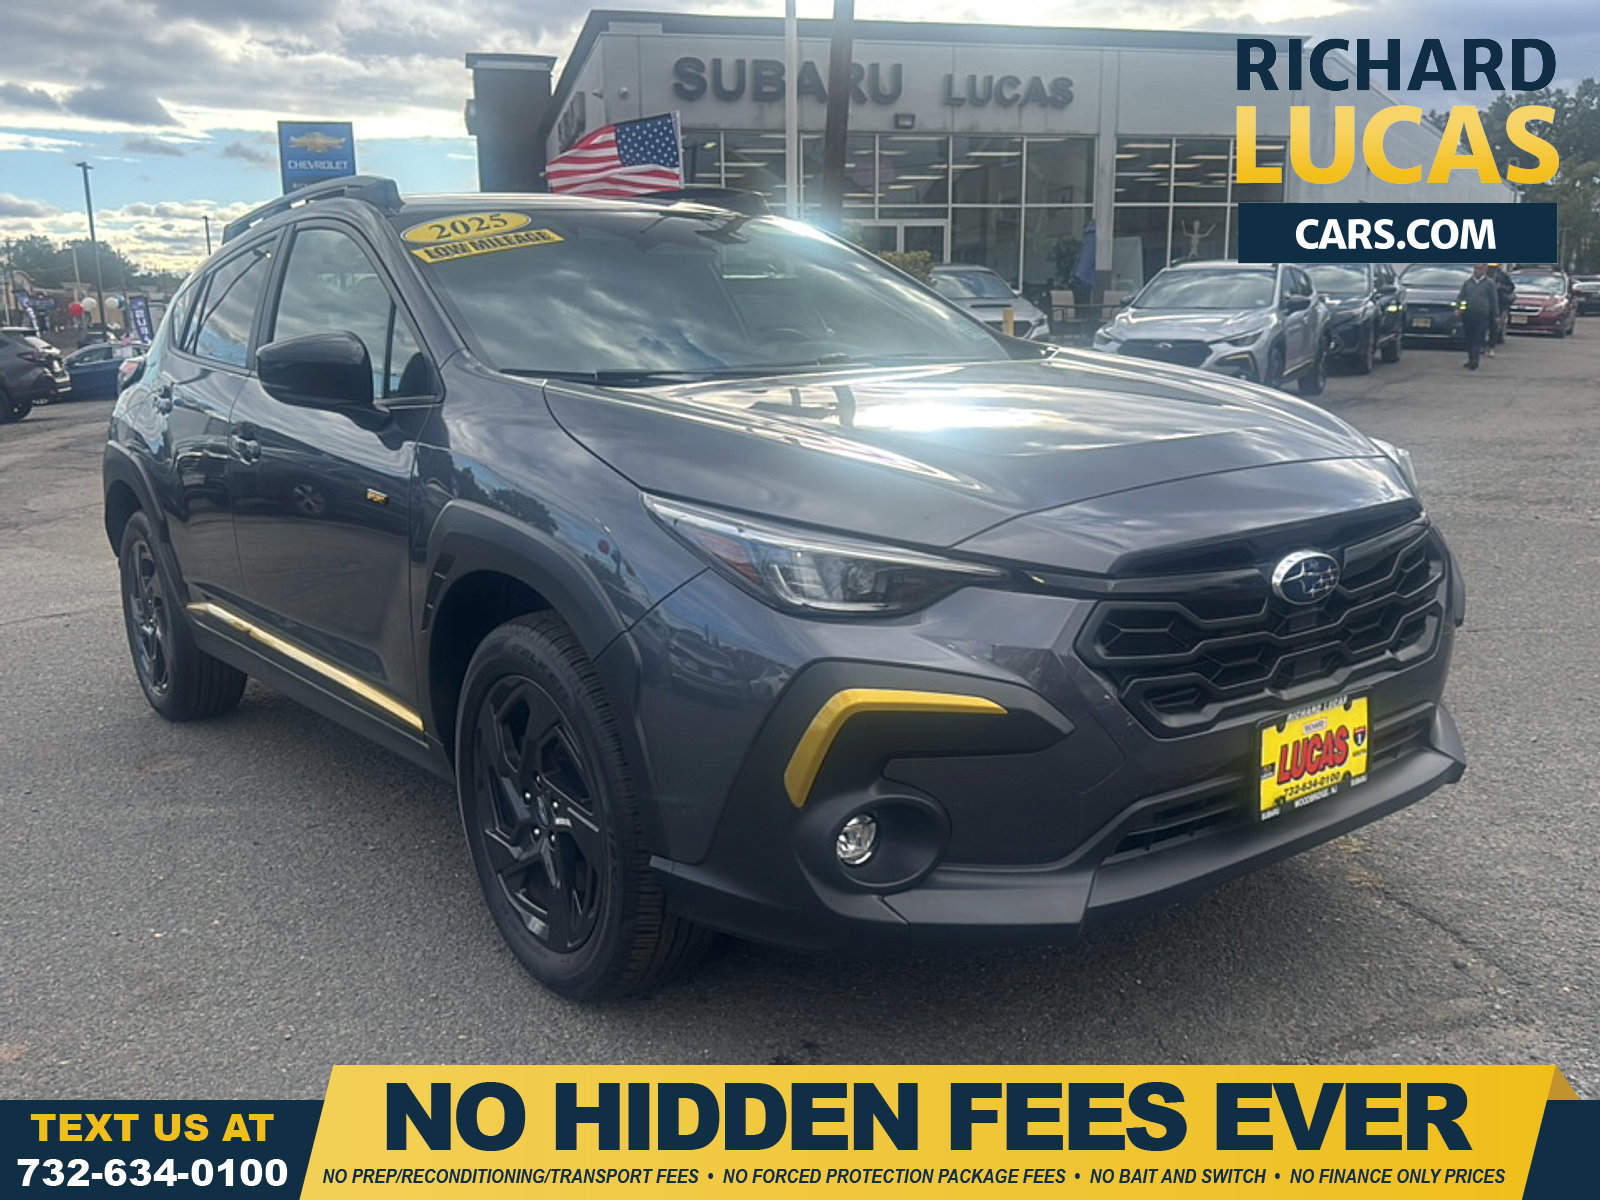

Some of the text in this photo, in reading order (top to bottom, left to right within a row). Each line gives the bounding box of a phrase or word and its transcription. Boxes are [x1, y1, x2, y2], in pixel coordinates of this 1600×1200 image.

[943, 73, 1075, 110] LUCAS
[288, 160, 348, 170] CHEVROLET
[428, 213, 508, 240] 2025
[424, 231, 551, 260] LOW MILEAGE
[1277, 725, 1349, 786] LUCAS
[1284, 771, 1342, 797] 732-634-0100
